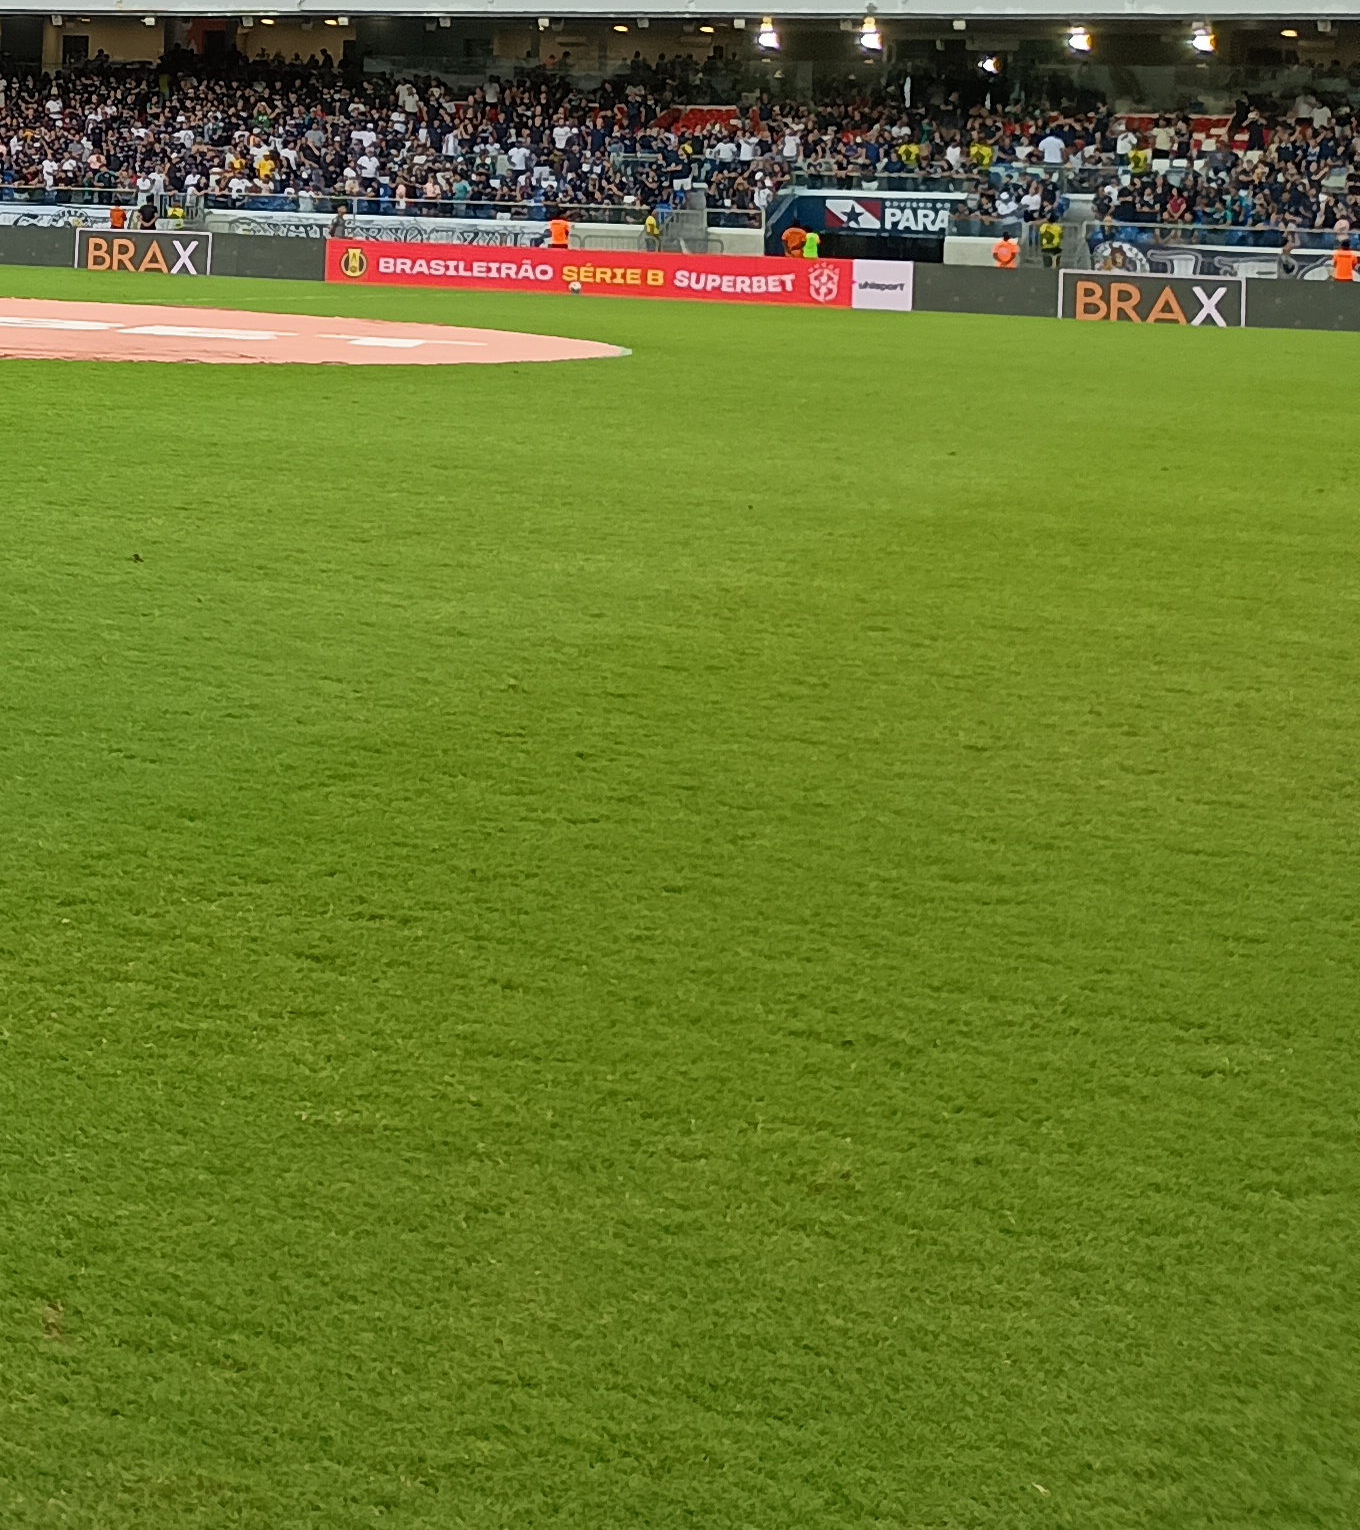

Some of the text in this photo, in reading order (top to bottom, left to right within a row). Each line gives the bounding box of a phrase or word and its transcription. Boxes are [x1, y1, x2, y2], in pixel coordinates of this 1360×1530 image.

[86, 237, 198, 275] BRAX
[377, 256, 796, 294] BRASILEIRÃO SÉRIE B SUPERBET
[1075, 281, 1228, 327] BRAX
